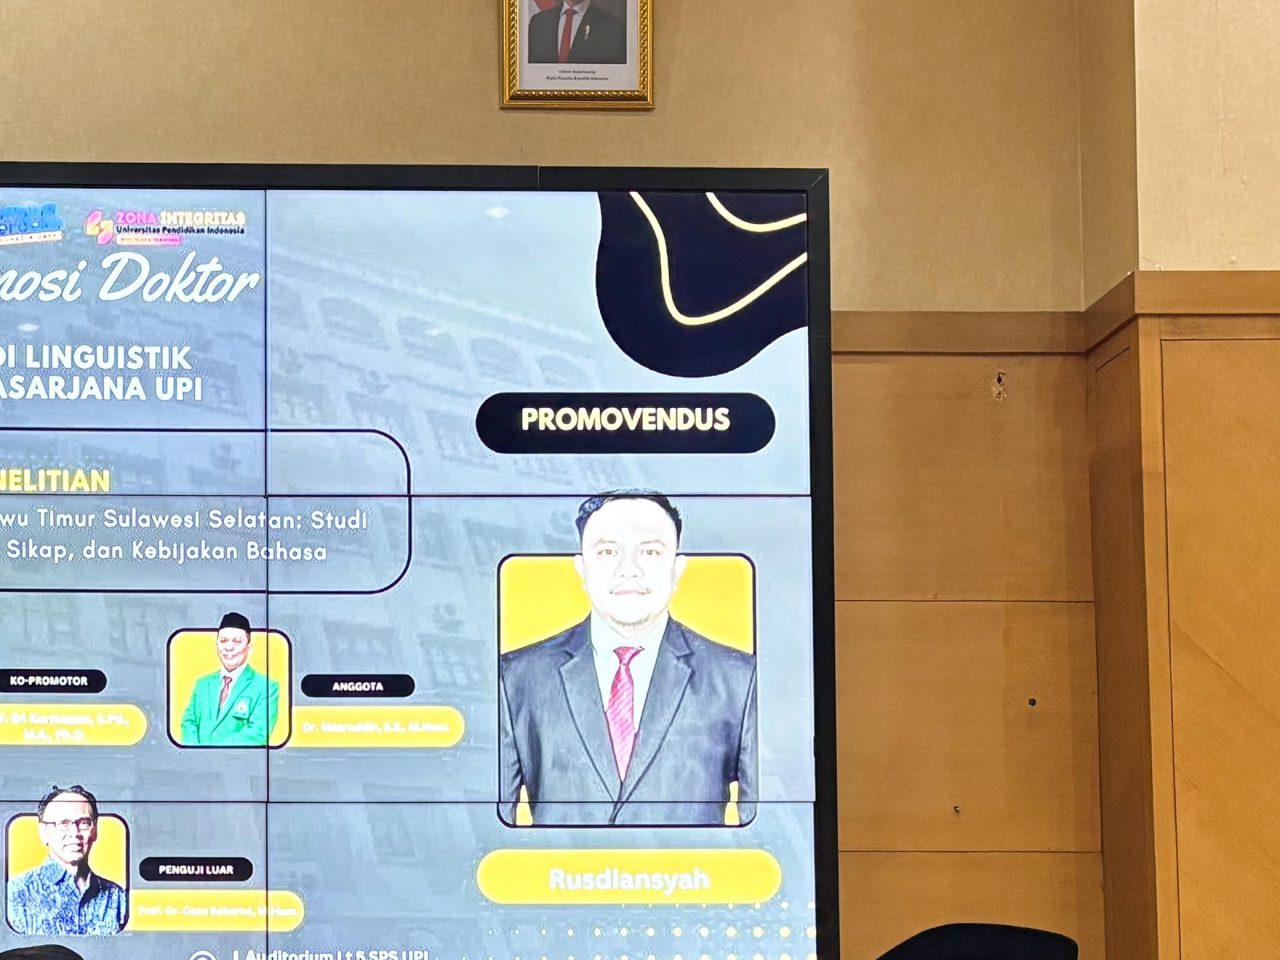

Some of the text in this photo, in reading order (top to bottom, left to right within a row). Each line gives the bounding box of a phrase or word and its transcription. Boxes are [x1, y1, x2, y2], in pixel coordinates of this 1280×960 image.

[117, 211, 246, 226] ZONA INTEGRITAS
[117, 225, 245, 236] Universitas Pendidikan Indonesia
[96, 251, 261, 303] Doktor
[26, 345, 193, 370] LINGUISTIK
[156, 376, 202, 401] UPI
[522, 406, 731, 431] PROMOVENDUS
[37, 507, 95, 528] Timur
[104, 508, 200, 529] Sulawesi
[209, 509, 302, 530] Selatan:
[311, 509, 368, 530] Studi
[6, 540, 74, 564] Sikap,
[83, 540, 122, 560] dan
[132, 541, 237, 564] Kebijakan
[247, 541, 327, 561] Bahasa
[10, 675, 88, 686] KO-PROMOTOR
[332, 681, 384, 692] ANGGOTA
[158, 865, 234, 875] PENGUJI LUAR
[549, 867, 710, 895] Rusdiansyah
